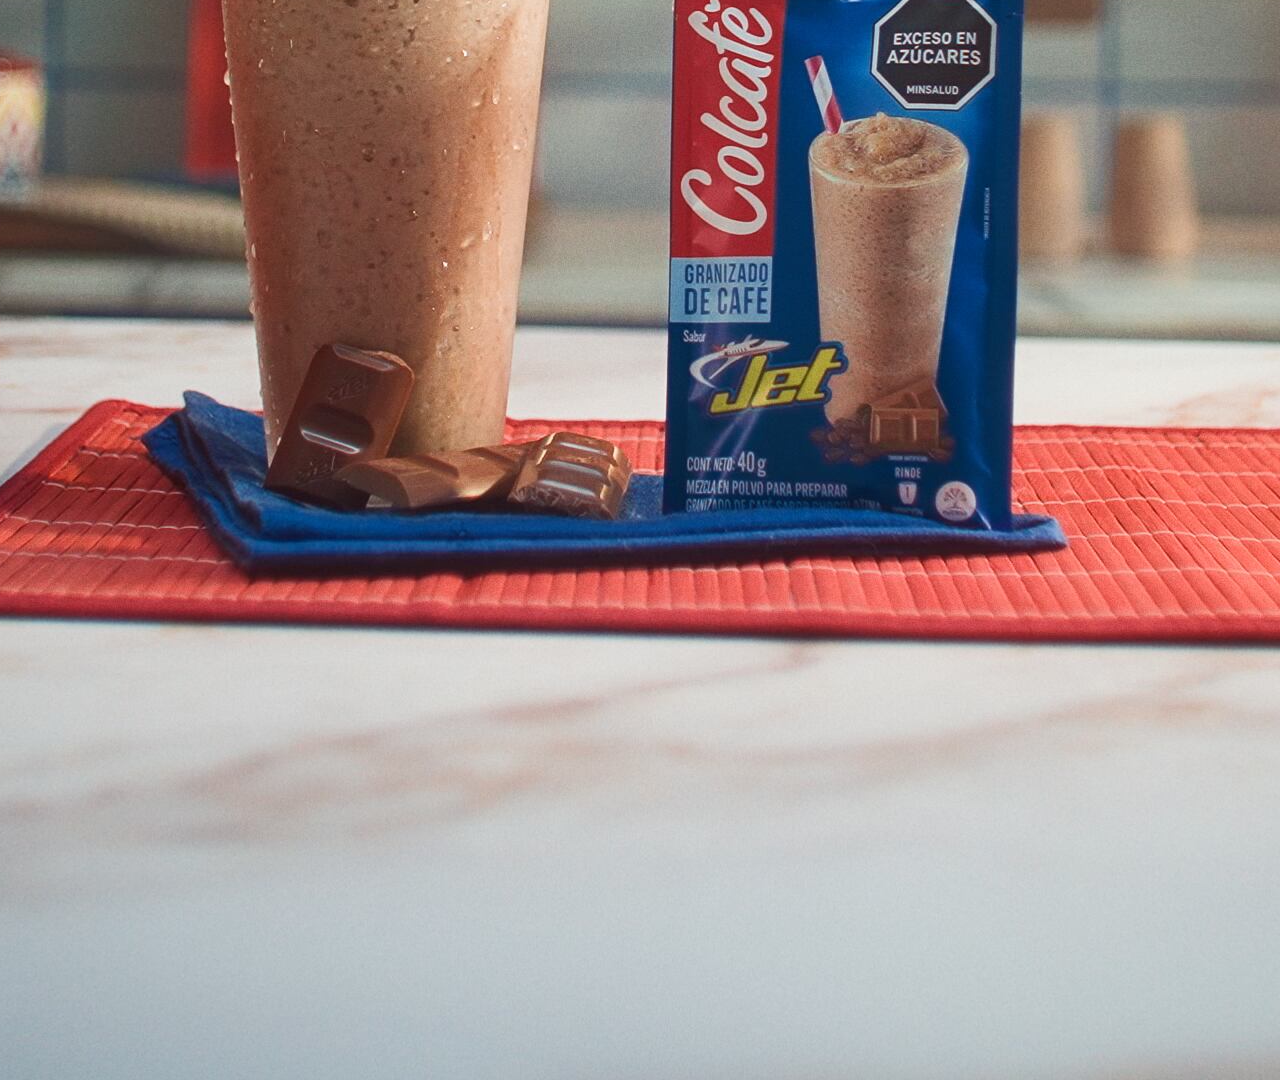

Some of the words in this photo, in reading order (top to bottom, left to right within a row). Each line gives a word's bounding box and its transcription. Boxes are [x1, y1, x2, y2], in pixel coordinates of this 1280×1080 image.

[893, 32, 952, 46] EXCESO
[956, 32, 977, 46] EN
[886, 45, 981, 65] AZÚCARES
[906, 85, 959, 95] MINSALUD
[684, 263, 769, 283] GRANIZADO
[684, 287, 711, 315] DE
[717, 284, 769, 315] CAFÉ
[683, 330, 706, 343] Sabor
[709, 346, 843, 414] Jet
[737, 451, 755, 472] 40
[757, 458, 767, 477] g
[894, 467, 921, 478] RINDE
[686, 480, 716, 494] MEZCLA
[717, 480, 730, 494] EN
[732, 480, 764, 495] POLVO
[766, 482, 793, 497] PARA
[795, 483, 848, 497] PREPARAR
